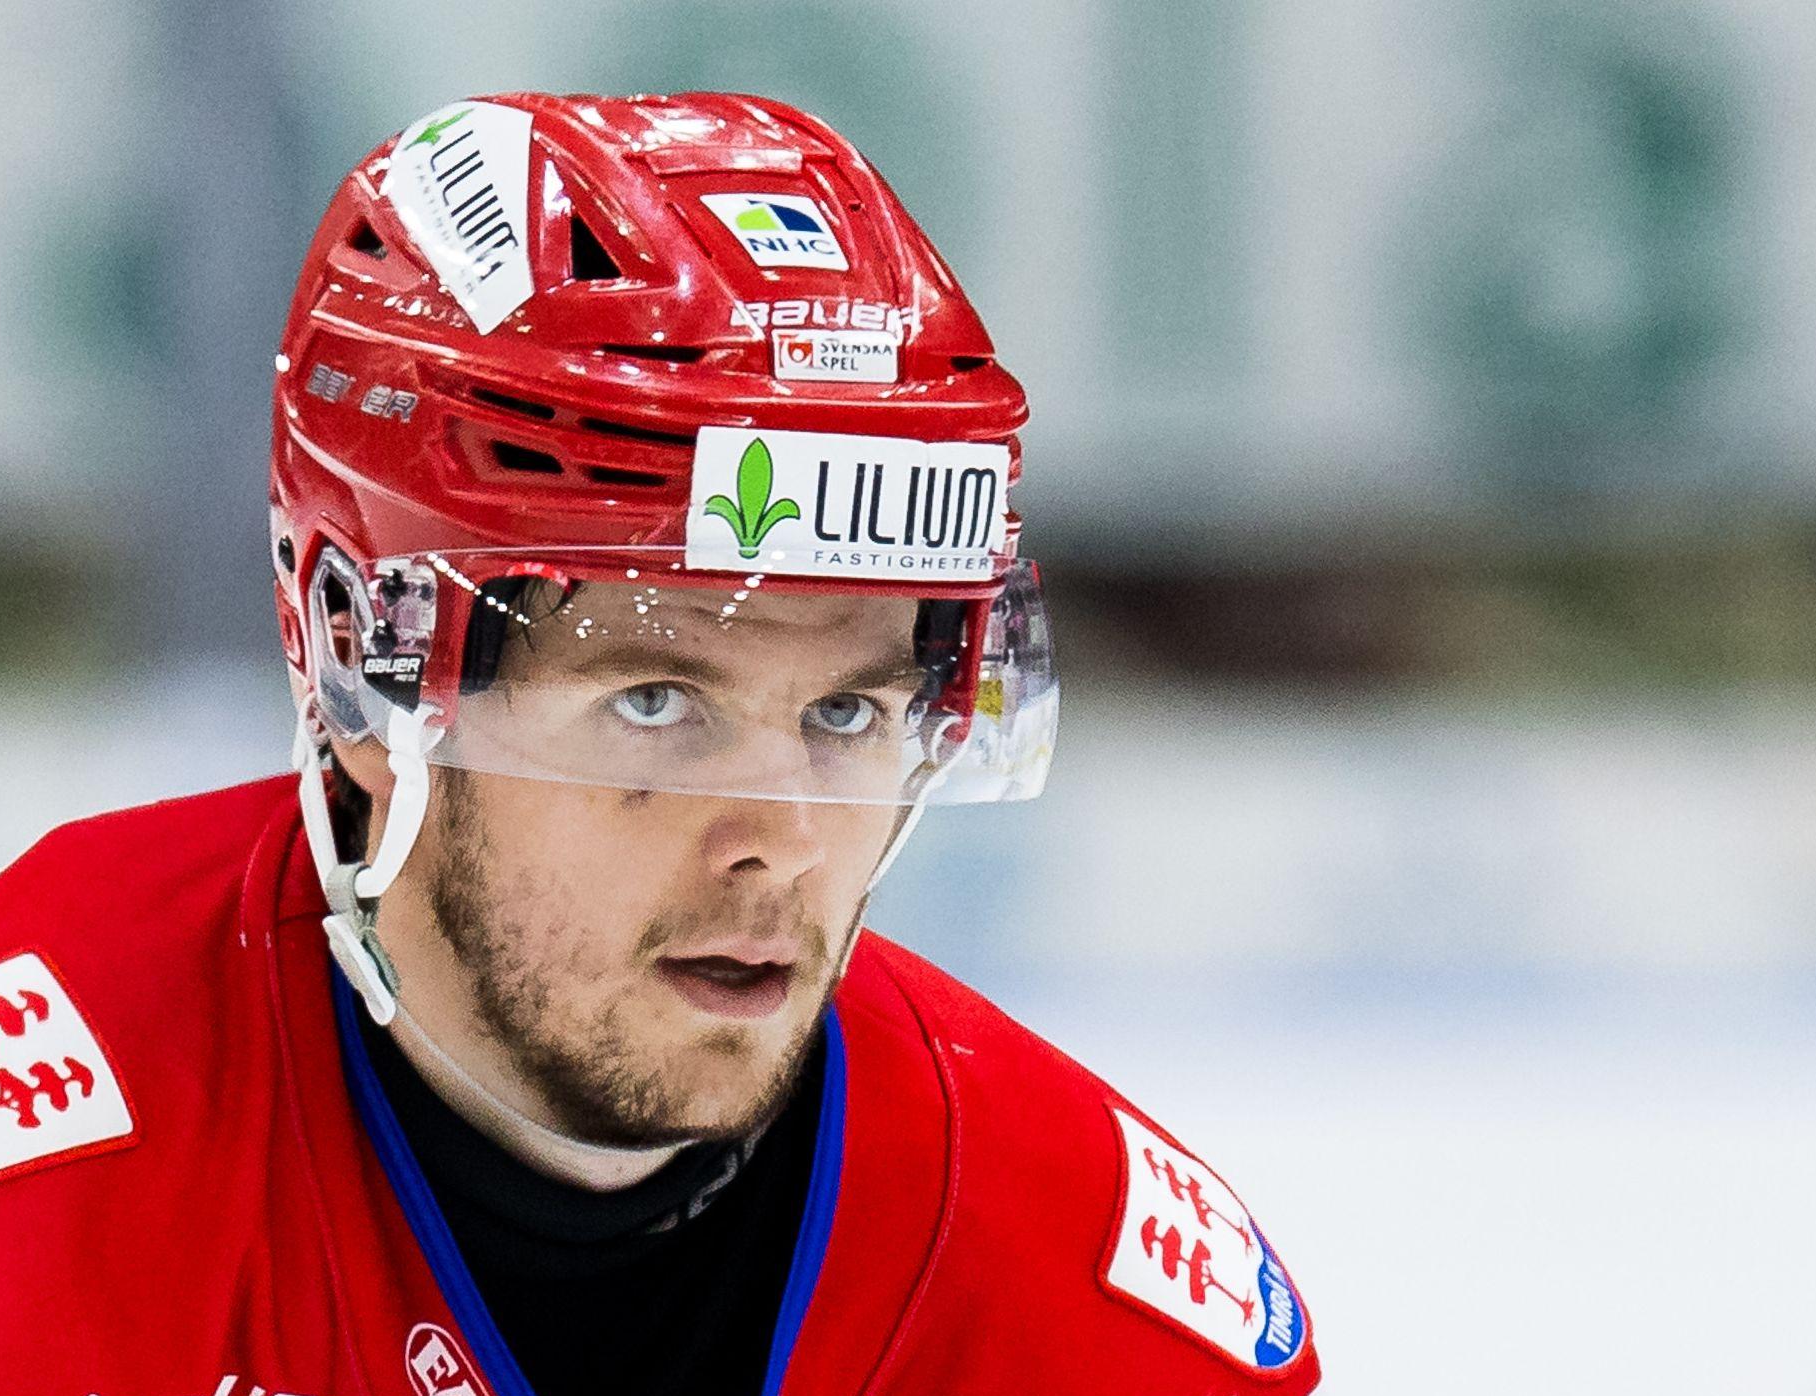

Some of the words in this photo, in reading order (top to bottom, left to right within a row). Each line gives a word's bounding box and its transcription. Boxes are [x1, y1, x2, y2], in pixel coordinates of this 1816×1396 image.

[746, 237, 836, 255] NHC
[820, 356, 859, 372] SPEL
[814, 461, 997, 549] LILIUM
[813, 550, 992, 571] FASTIGHETER
[364, 657, 421, 674] BAUER
